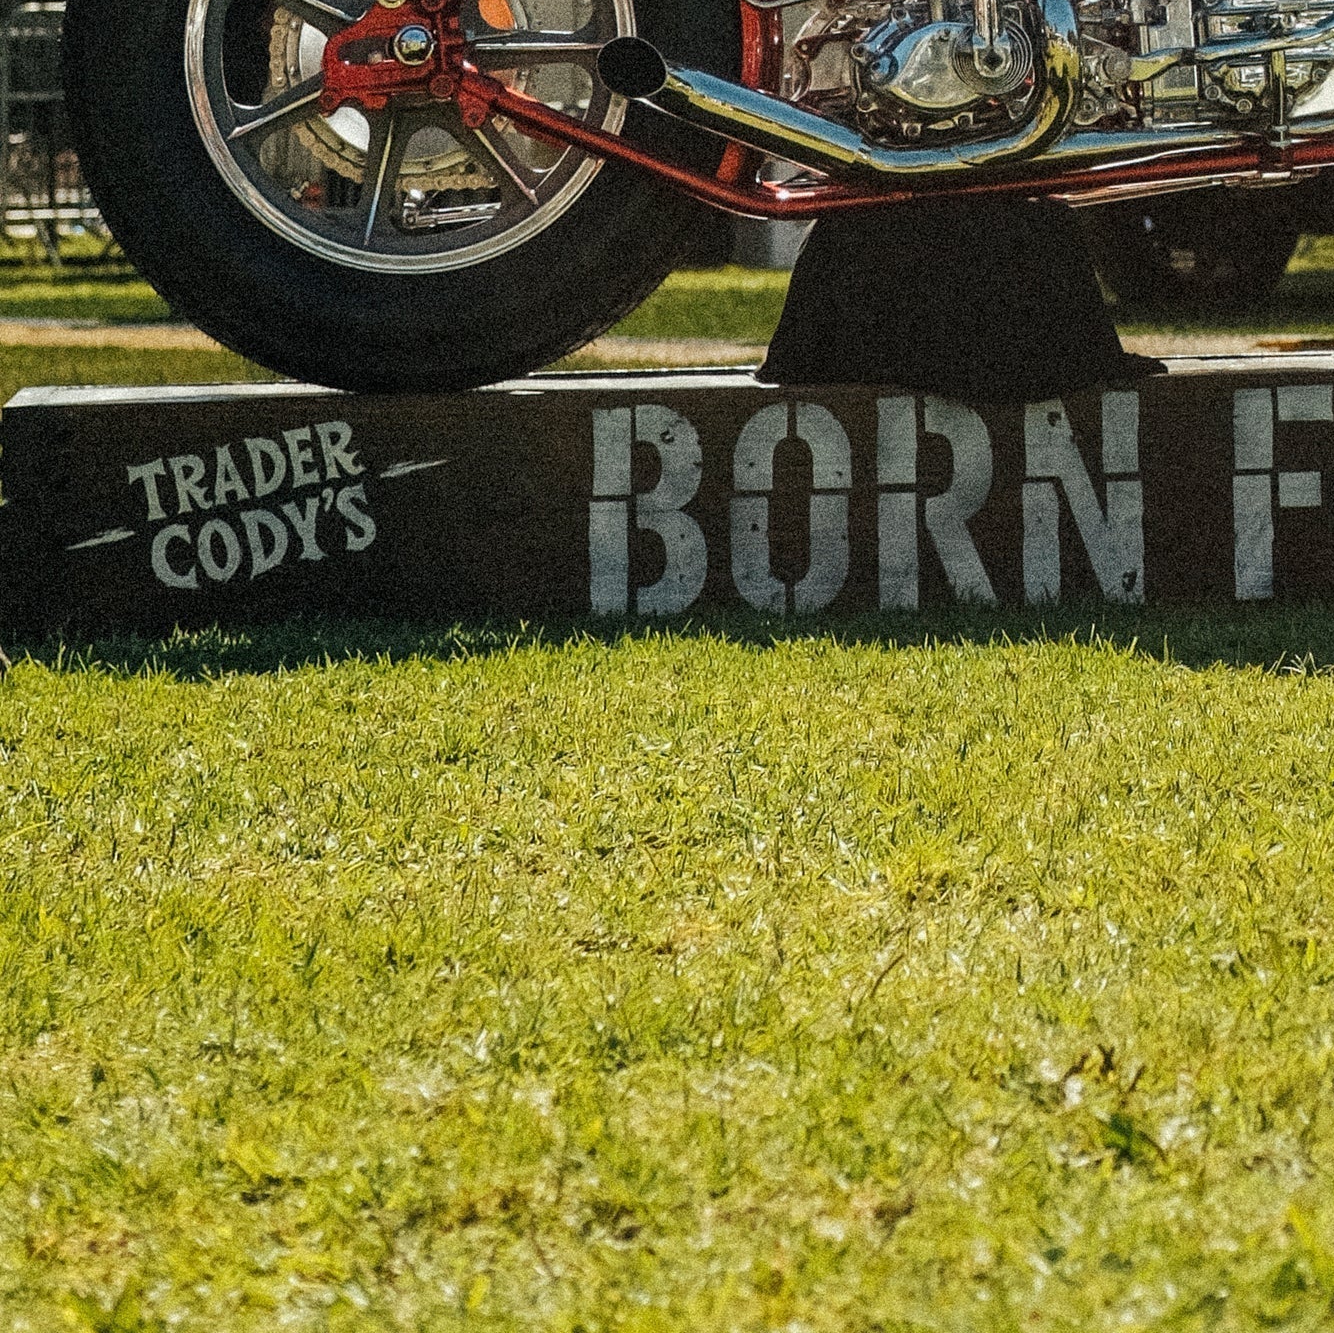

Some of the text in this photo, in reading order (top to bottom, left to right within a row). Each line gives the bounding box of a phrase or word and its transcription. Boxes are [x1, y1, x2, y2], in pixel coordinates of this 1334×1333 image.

[127, 419, 366, 524] TRADER
[588, 389, 1146, 617] BORN
[150, 482, 378, 591] CODY'S
